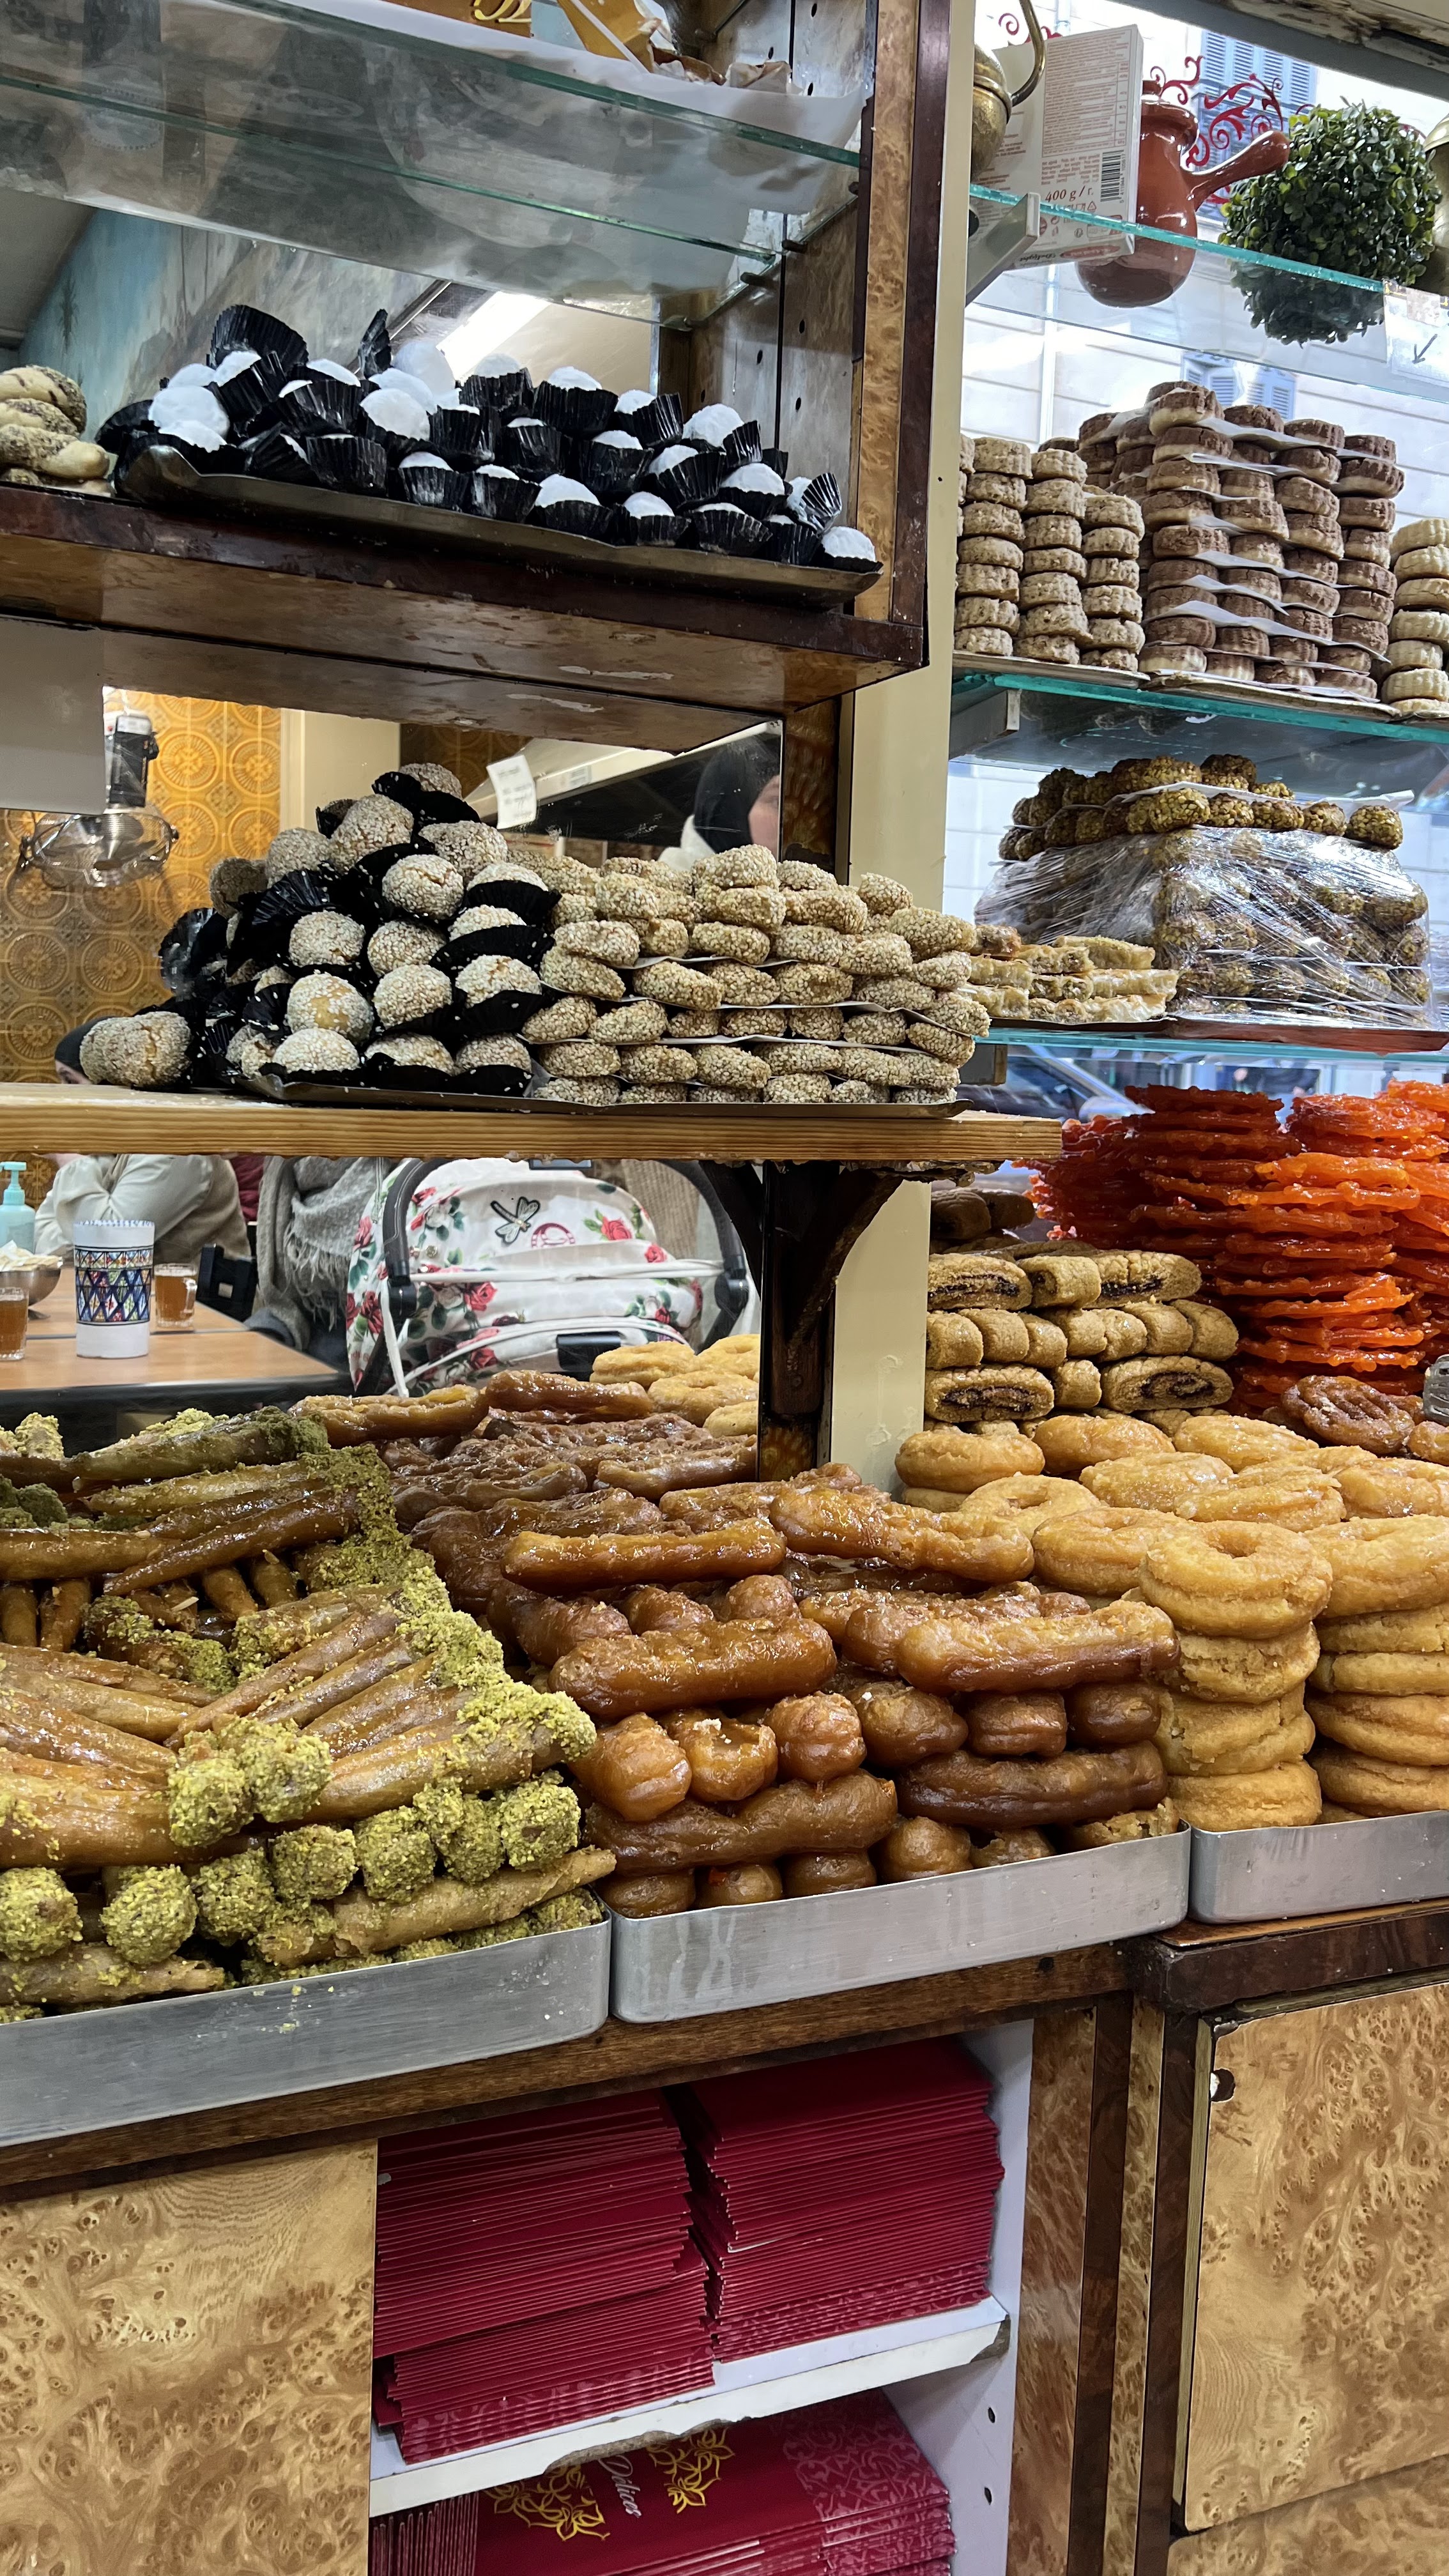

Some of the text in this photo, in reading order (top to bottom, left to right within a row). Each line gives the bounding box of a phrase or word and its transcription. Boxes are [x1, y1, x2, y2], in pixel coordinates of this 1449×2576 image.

[1045, 189, 1066, 203] 400
[1069, 190, 1077, 202] g
[1078, 185, 1085, 197] /
[599, 2455, 642, 2518] Délices
